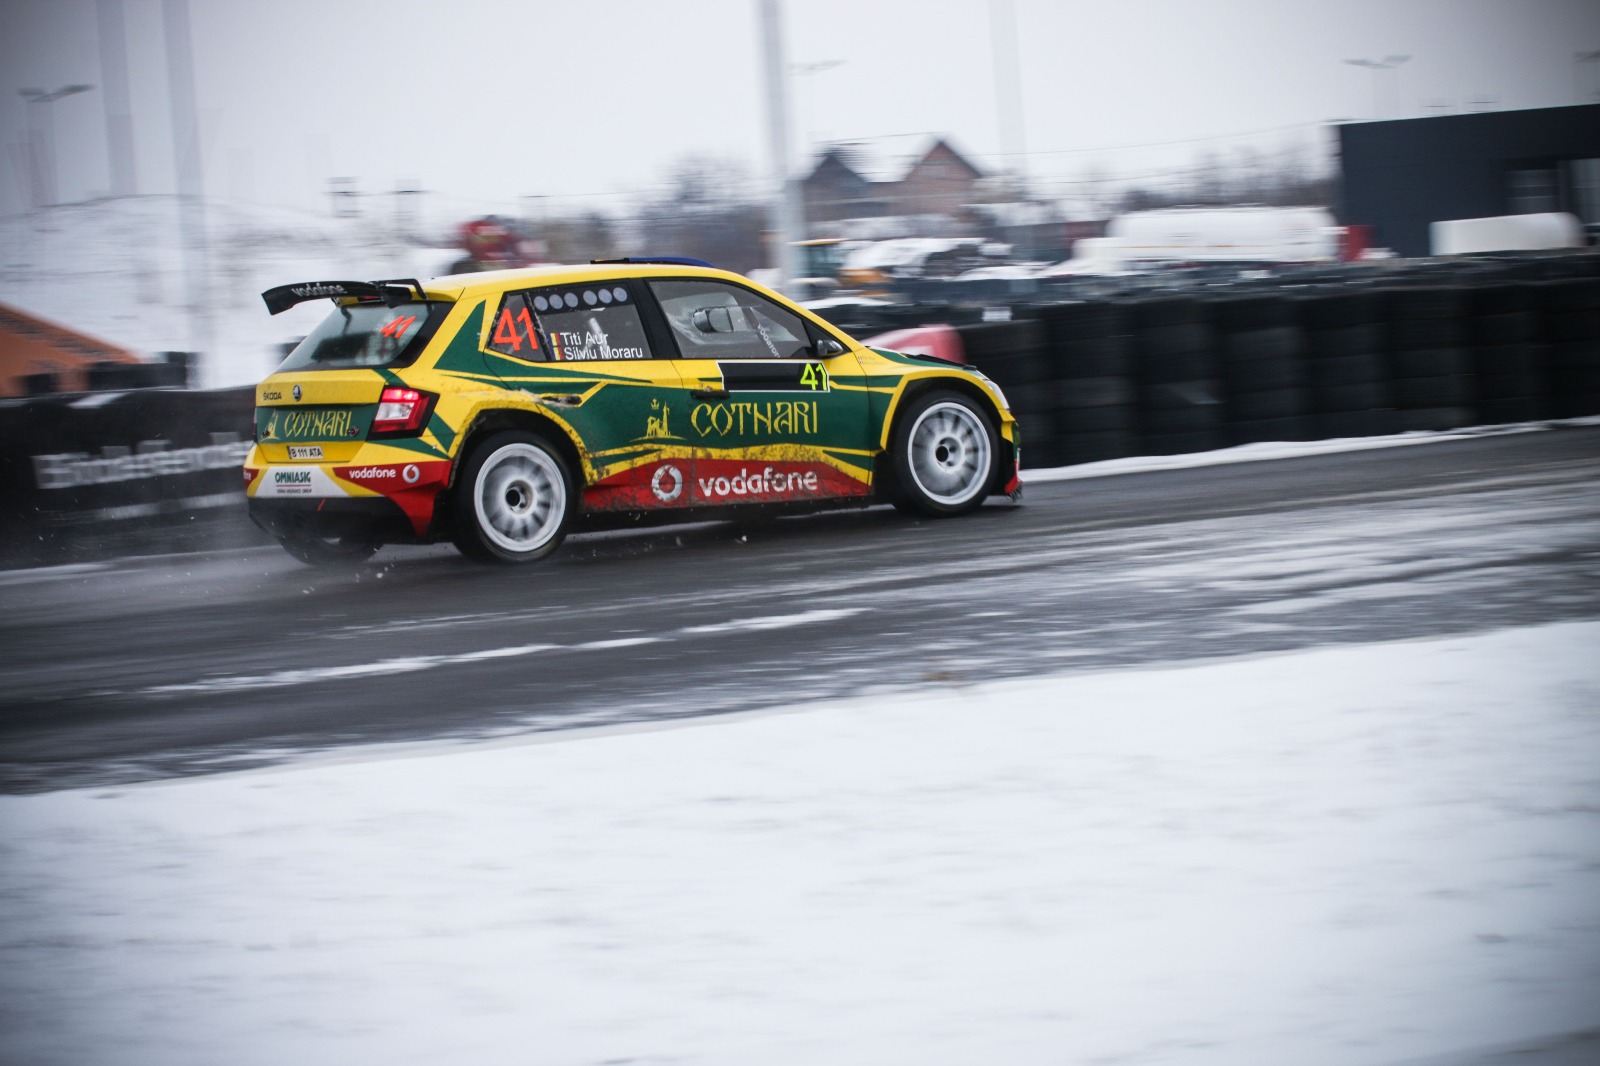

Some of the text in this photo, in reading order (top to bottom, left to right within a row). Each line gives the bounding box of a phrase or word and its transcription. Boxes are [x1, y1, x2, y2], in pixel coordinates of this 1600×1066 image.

[292, 282, 348, 297] vodafone
[380, 315, 417, 339] 41
[494, 307, 539, 351] 41
[560, 332, 609, 346] Titi Aur
[600, 346, 643, 360] Moraru
[800, 362, 828, 391] 41
[284, 410, 353, 437] COTNARI
[691, 401, 818, 437] COTNARI
[291, 447, 323, 458] B 111 ATA
[275, 471, 312, 484] OMNIASIG
[349, 466, 397, 480] vodafone
[698, 466, 818, 497] vodafone
